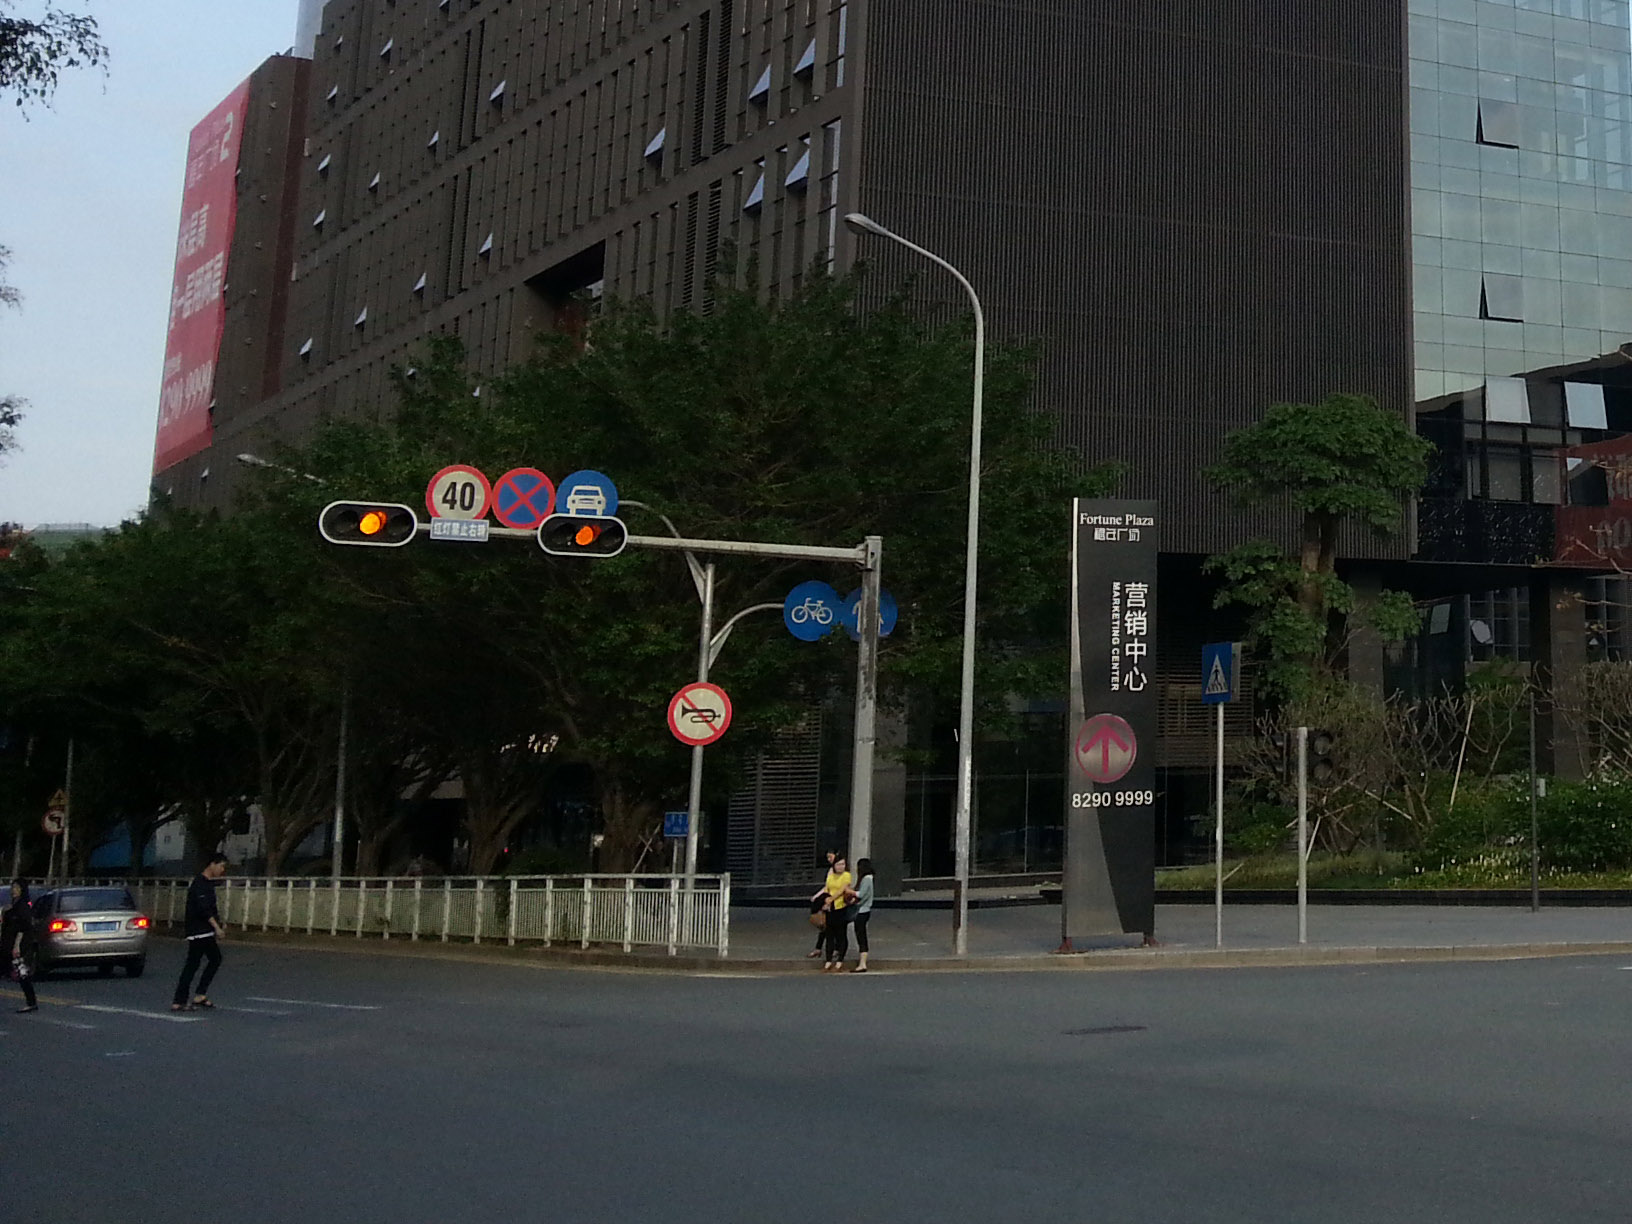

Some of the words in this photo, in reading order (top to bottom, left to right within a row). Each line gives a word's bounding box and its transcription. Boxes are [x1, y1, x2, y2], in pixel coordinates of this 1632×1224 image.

[441, 481, 475, 511] 40
[1080, 512, 1123, 526] Fortune
[1125, 513, 1154, 526] Plaza
[1111, 581, 1120, 645] MARKETING
[1123, 582, 1148, 691] 营销中心
[1111, 647, 1120, 691] CENTER
[1072, 792, 1111, 808] 8290
[1115, 790, 1153, 807] 9999
